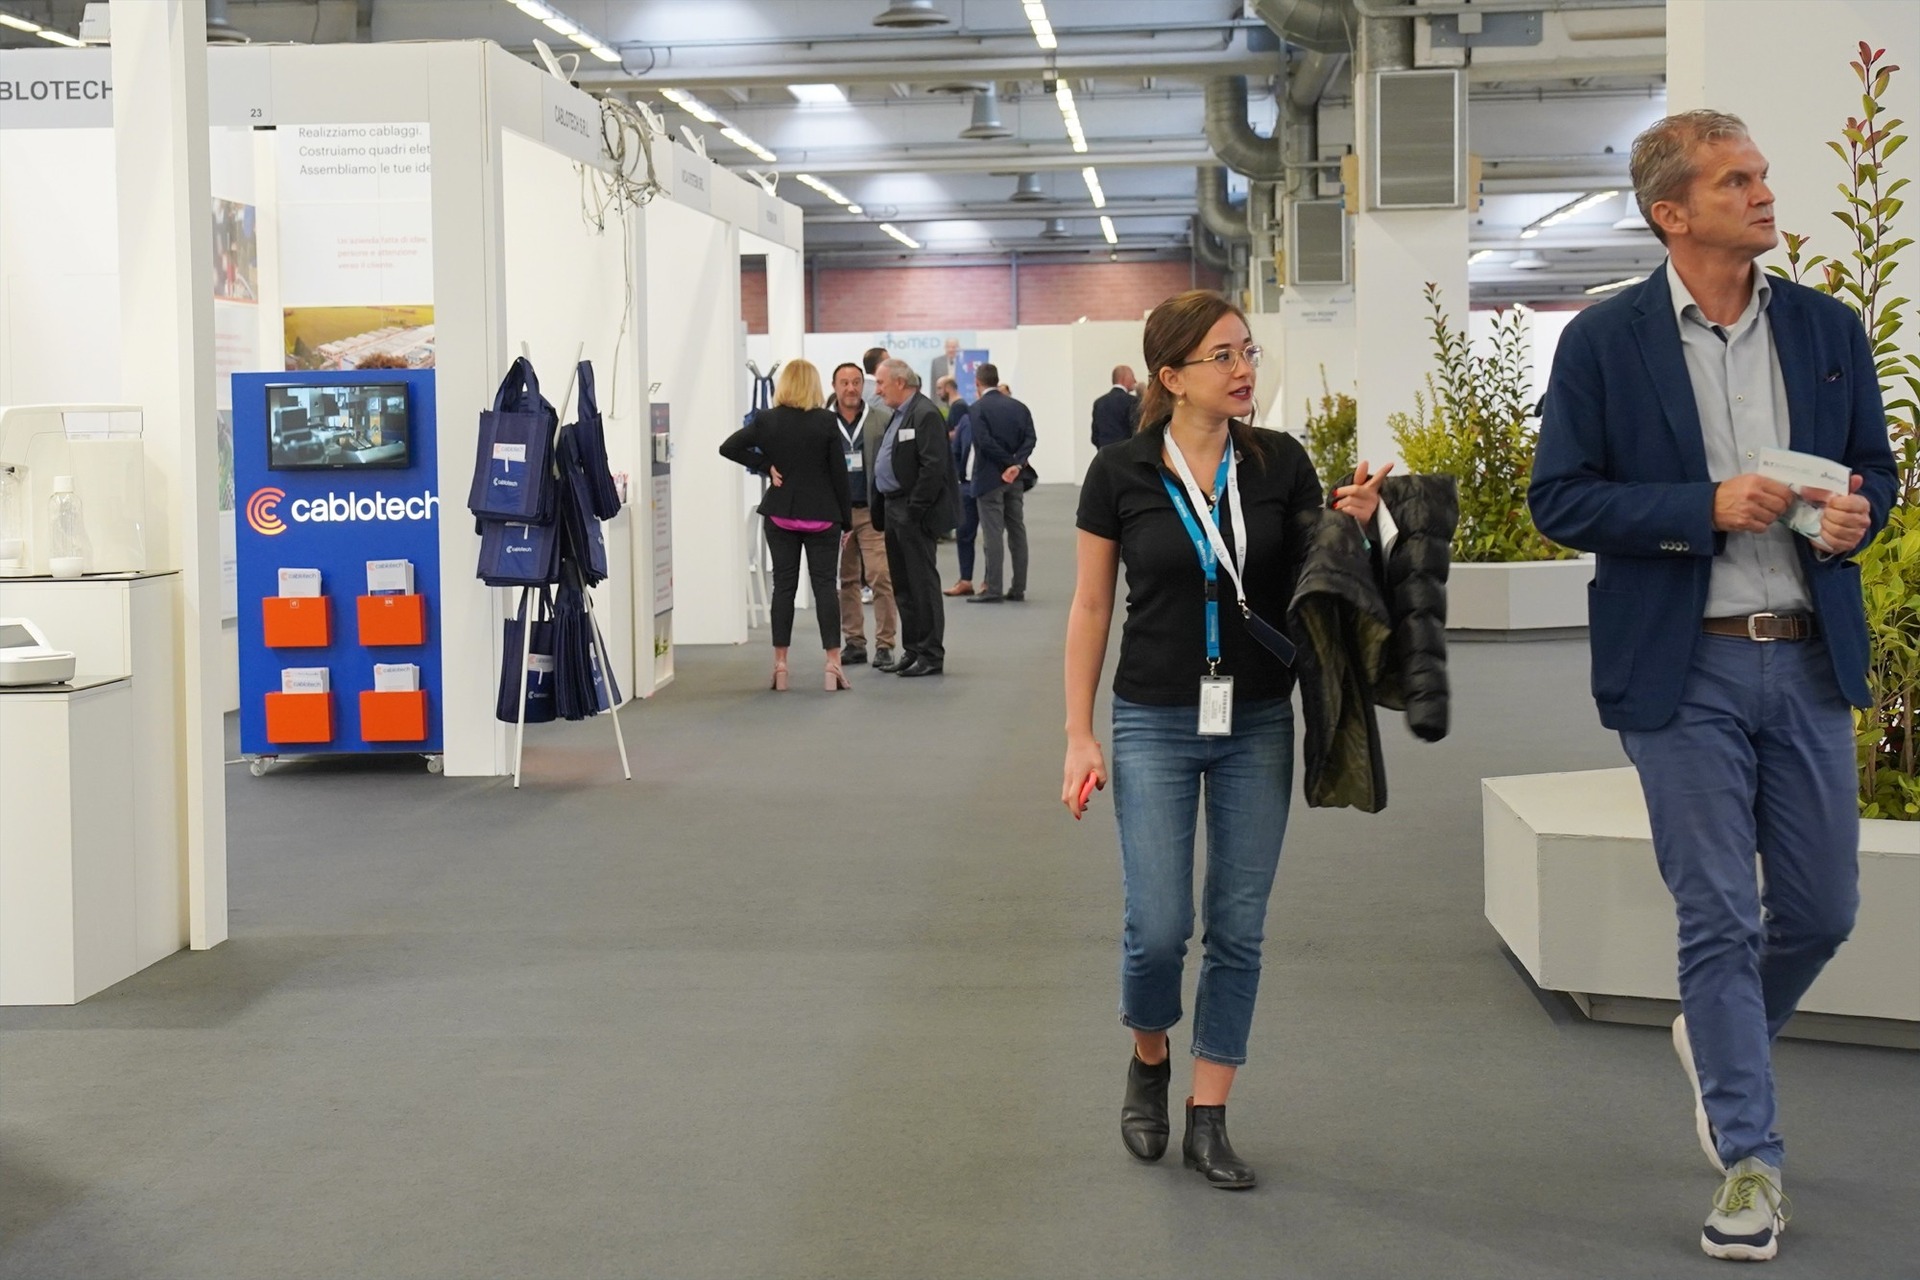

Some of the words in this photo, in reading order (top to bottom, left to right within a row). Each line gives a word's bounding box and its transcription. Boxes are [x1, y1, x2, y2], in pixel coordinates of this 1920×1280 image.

[250, 108, 262, 118] 23
[299, 126, 367, 138] Realizziamo
[369, 125, 422, 138] cablaggi.
[299, 145, 366, 157] Costruiamo
[368, 144, 406, 157] quadri
[299, 164, 377, 175] Assembliamo
[380, 163, 390, 173] le
[393, 164, 412, 173] tue
[291, 490, 439, 522] cablotech
